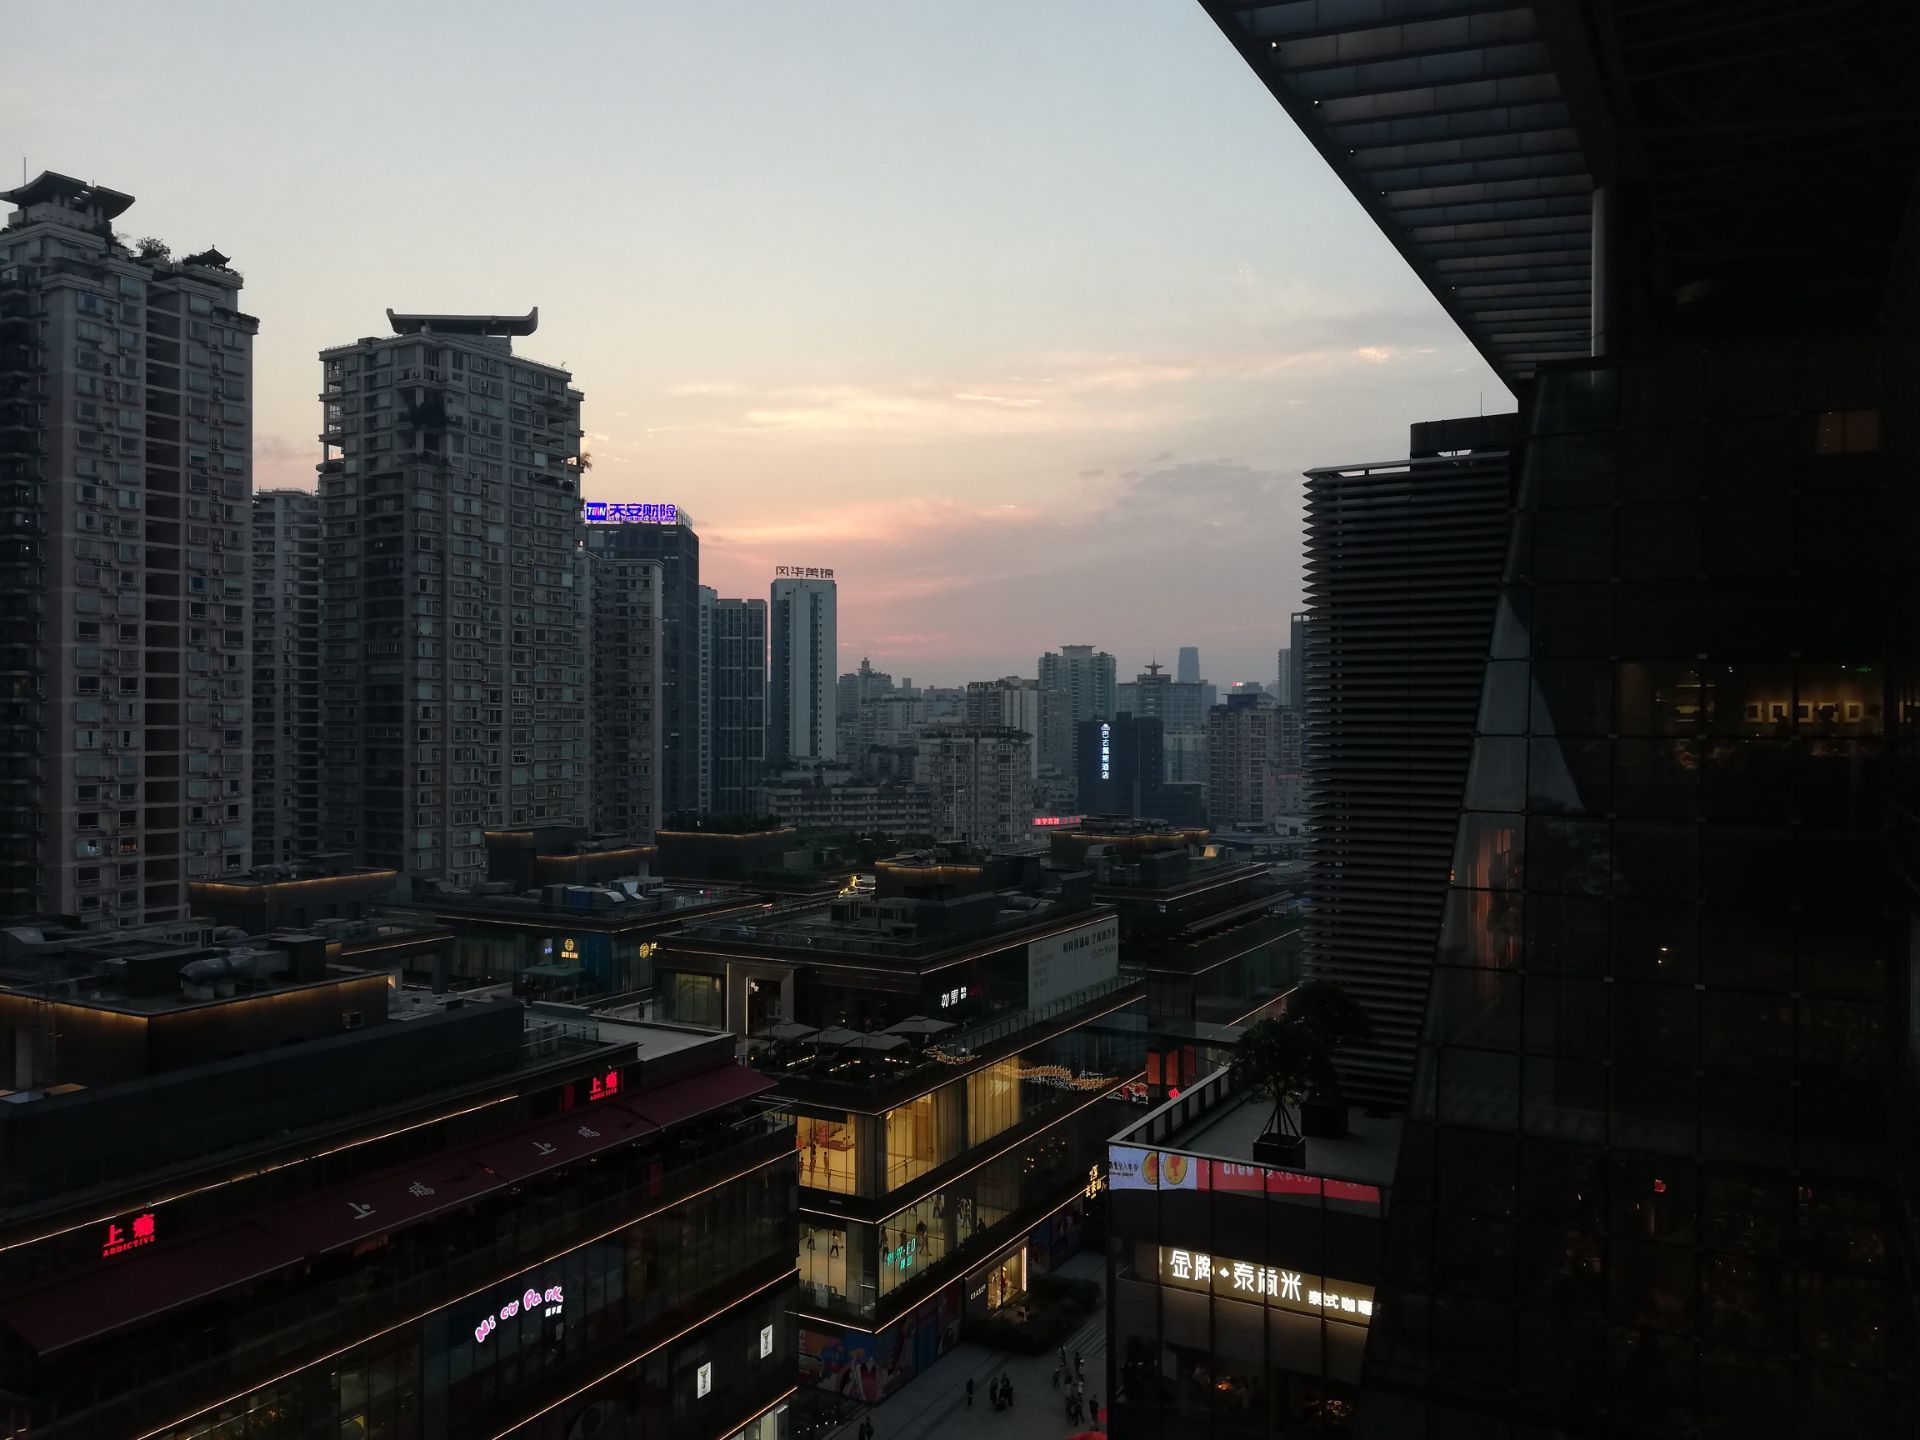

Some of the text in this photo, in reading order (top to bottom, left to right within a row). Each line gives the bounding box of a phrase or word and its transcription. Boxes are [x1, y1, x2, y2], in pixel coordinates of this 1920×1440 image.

[609, 503, 676, 519] 天安财险
[103, 1235, 154, 1257] ADDICTIVE
